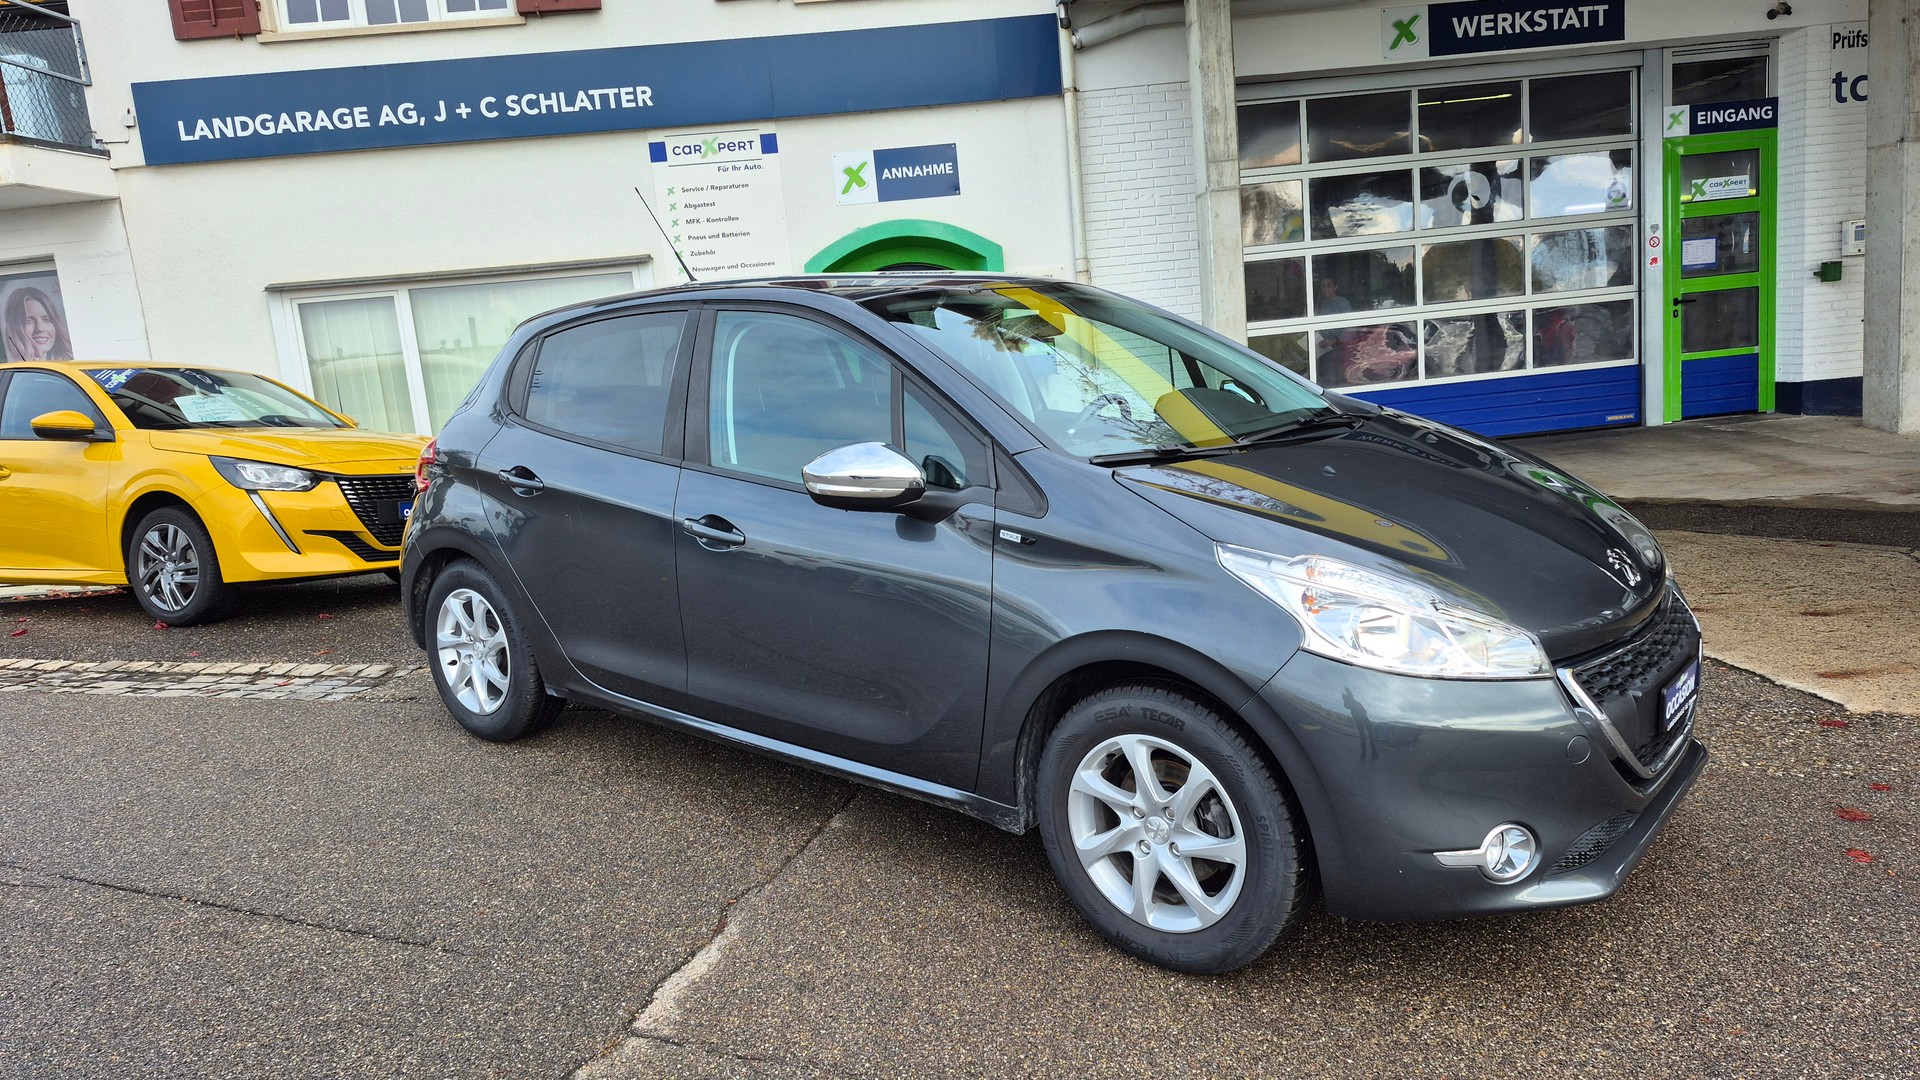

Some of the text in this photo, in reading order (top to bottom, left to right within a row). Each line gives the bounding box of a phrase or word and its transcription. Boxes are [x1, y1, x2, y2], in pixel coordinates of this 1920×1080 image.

[1451, 5, 1609, 39] WERKSTATT
[1832, 29, 1868, 50] Prüfs
[177, 85, 655, 142] LANDGARAGE AG, J + C SCHLATTER
[1697, 106, 1773, 125] EINGANG
[717, 163, 764, 173] Für Ihr Auto.
[881, 162, 954, 180] ANNAHME
[710, 183, 749, 192] Reparaturen
[683, 201, 716, 210] Abgastest
[706, 215, 740, 224] Kontrollen
[721, 230, 751, 238] Batterien
[690, 249, 716, 257] Zubehör
[692, 265, 726, 273] Neuwagen
[740, 261, 776, 269] Occasionen
[1140, 706, 1186, 732] TECAR
[1256, 815, 1275, 861] SPIRIT
